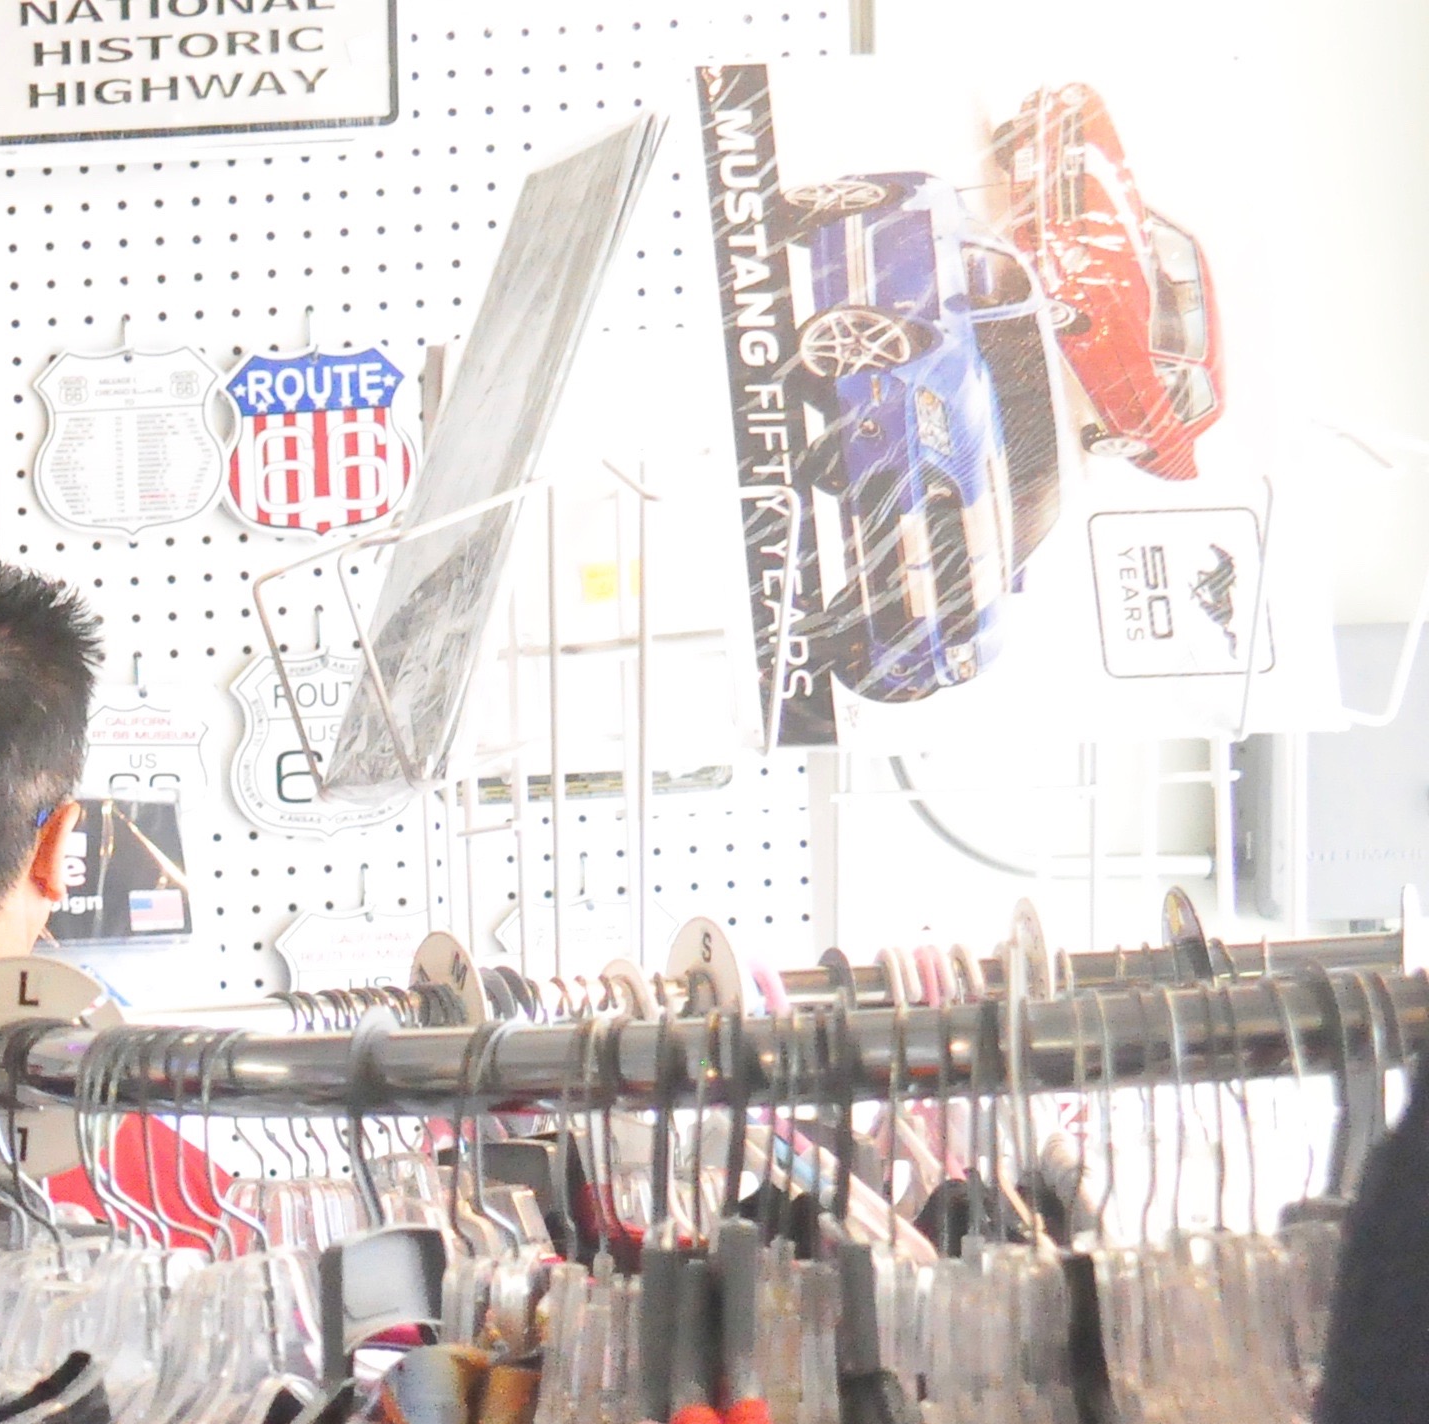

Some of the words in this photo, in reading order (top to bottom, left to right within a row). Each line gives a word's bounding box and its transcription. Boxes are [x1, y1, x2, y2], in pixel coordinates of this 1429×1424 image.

[34, 27, 324, 66] HISTORIC
[29, 68, 328, 108] HIGHWAY
[714, 109, 780, 369] MUSTANG
[246, 363, 384, 405] ROUTE
[254, 422, 389, 514] 66
[744, 383, 793, 519] FIFTY
[1117, 547, 1145, 642] YEARS
[1141, 546, 1174, 640] 50
[759, 539, 814, 699] YEARS
[135, 731, 197, 740] MUSEUM
[129, 753, 157, 769] US
[275, 750, 324, 804] 6
[702, 931, 712, 963] S
[18, 970, 39, 1006] L
[450, 951, 468, 991] M
